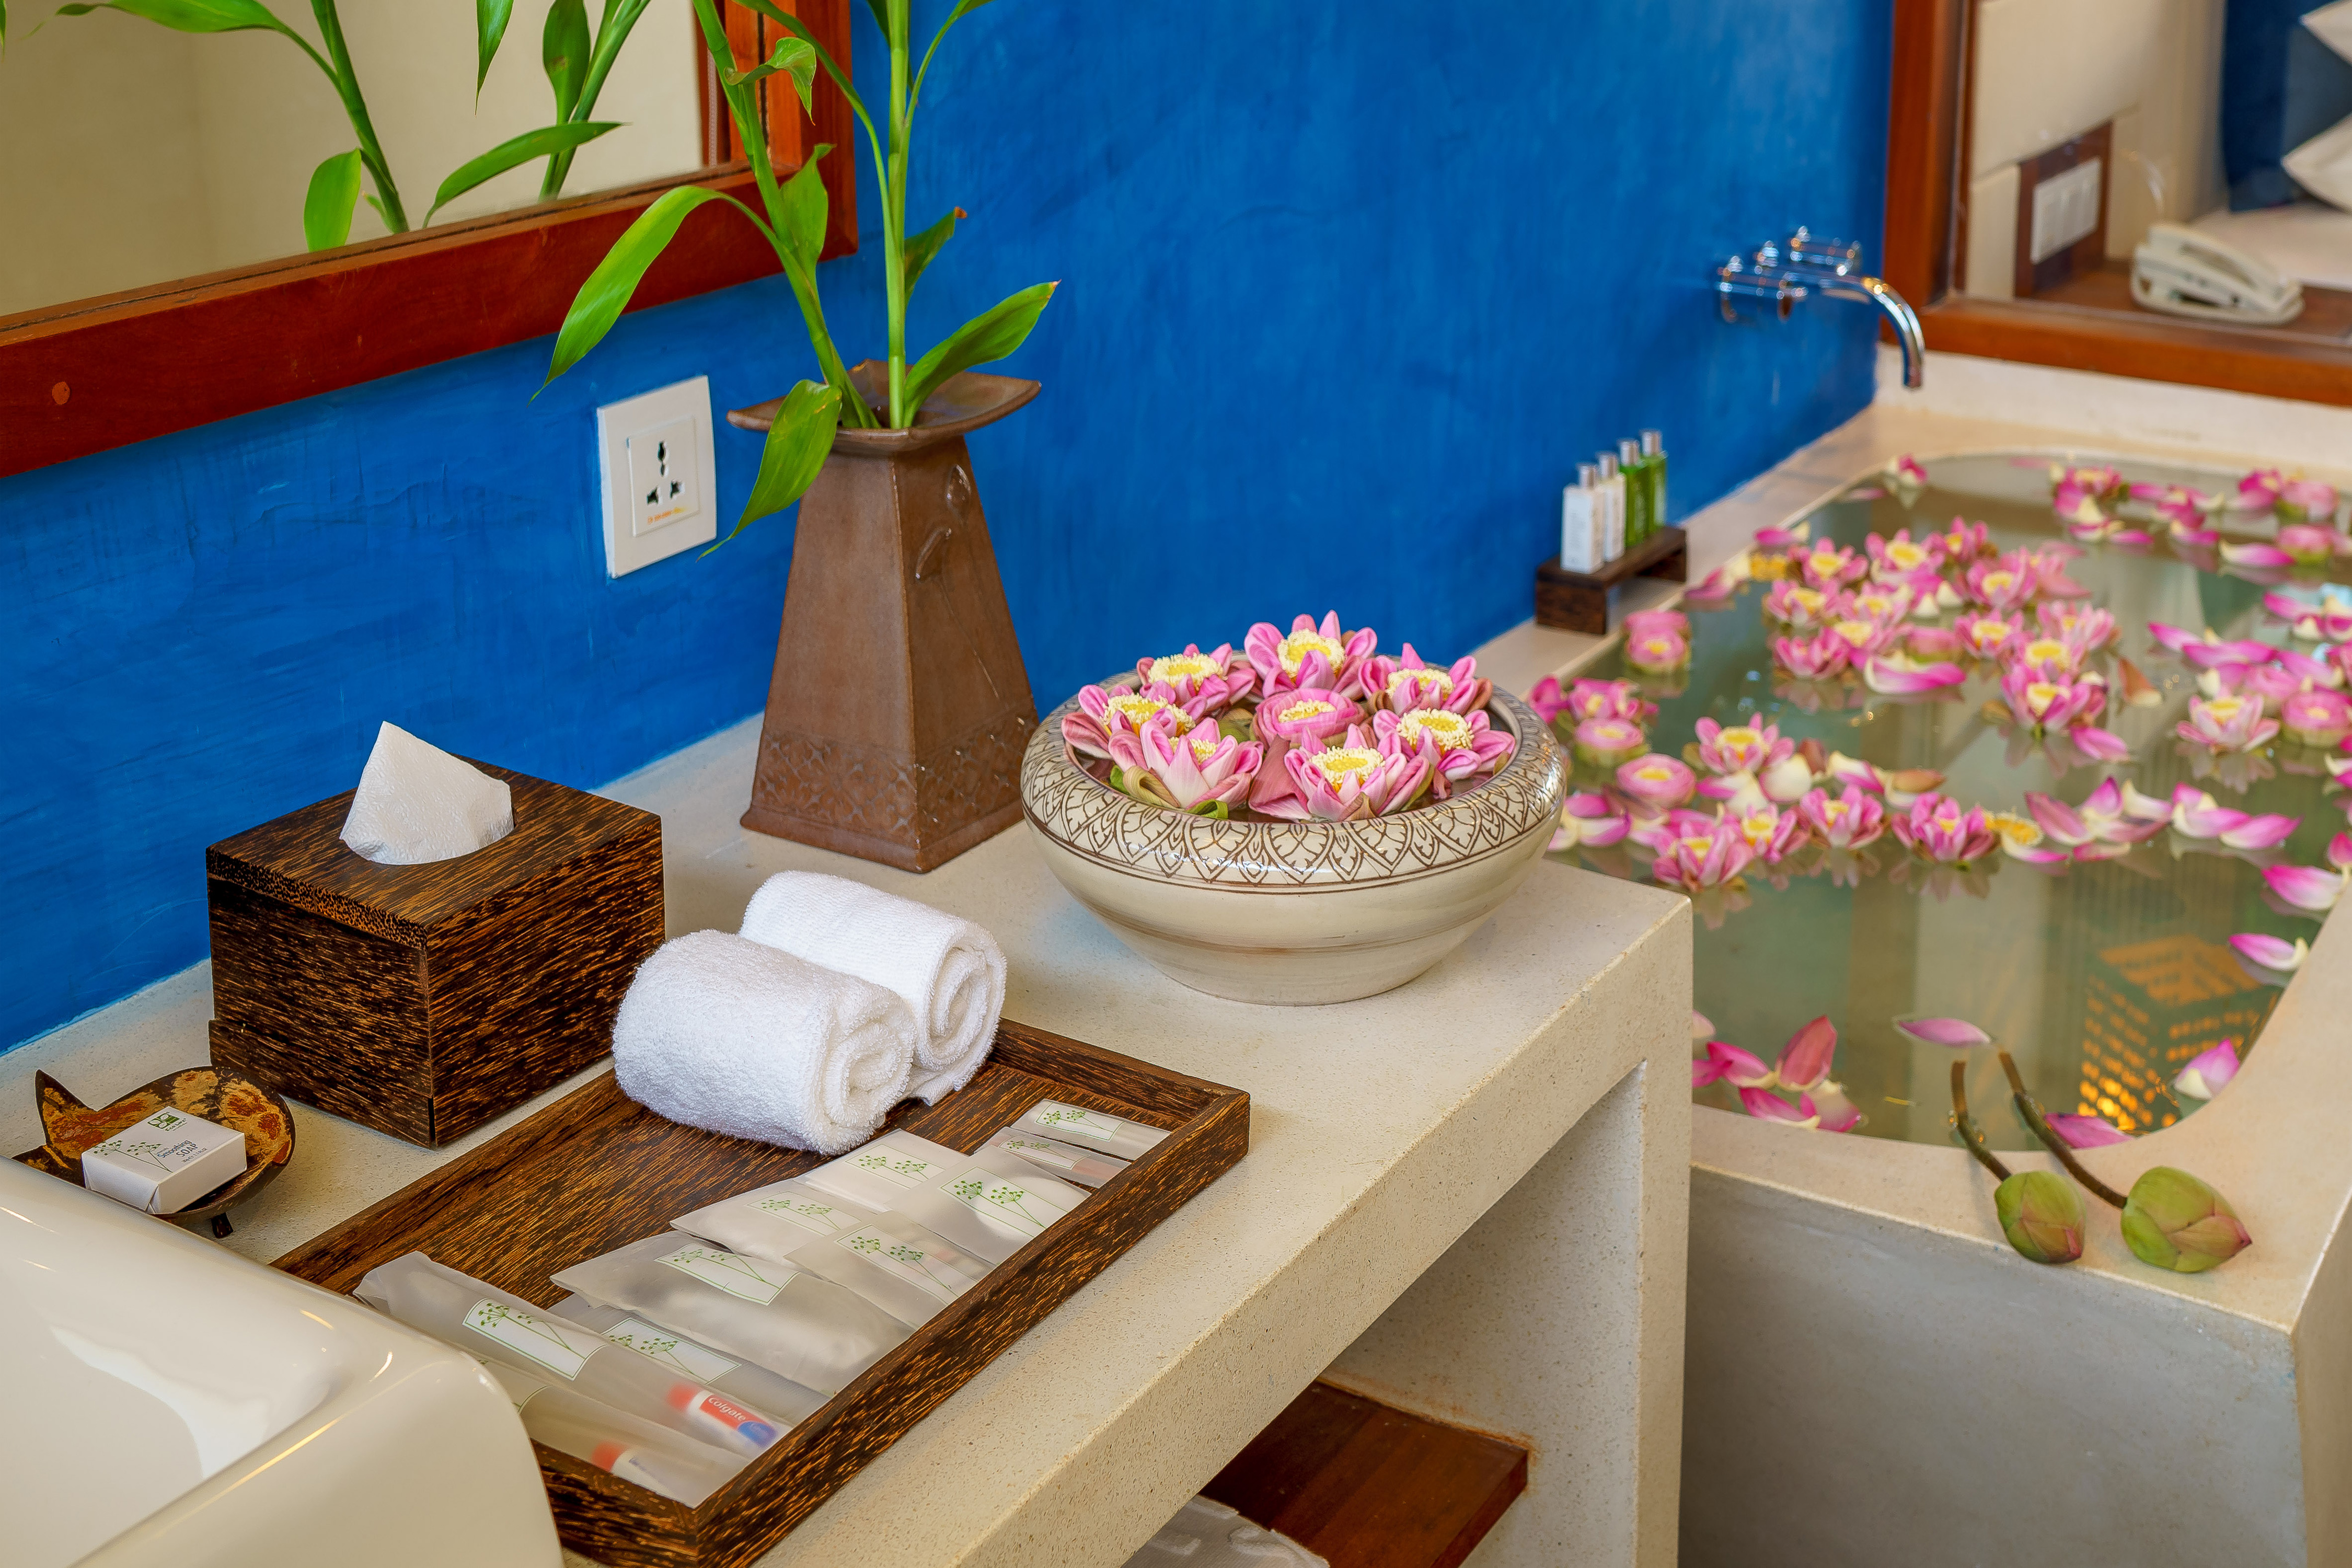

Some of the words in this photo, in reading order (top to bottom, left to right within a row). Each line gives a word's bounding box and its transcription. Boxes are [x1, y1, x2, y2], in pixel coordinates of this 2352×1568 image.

[157, 1140, 192, 1158] Smoothing
[176, 1143, 198, 1157] SOAP
[708, 1397, 746, 1421] Colgate
